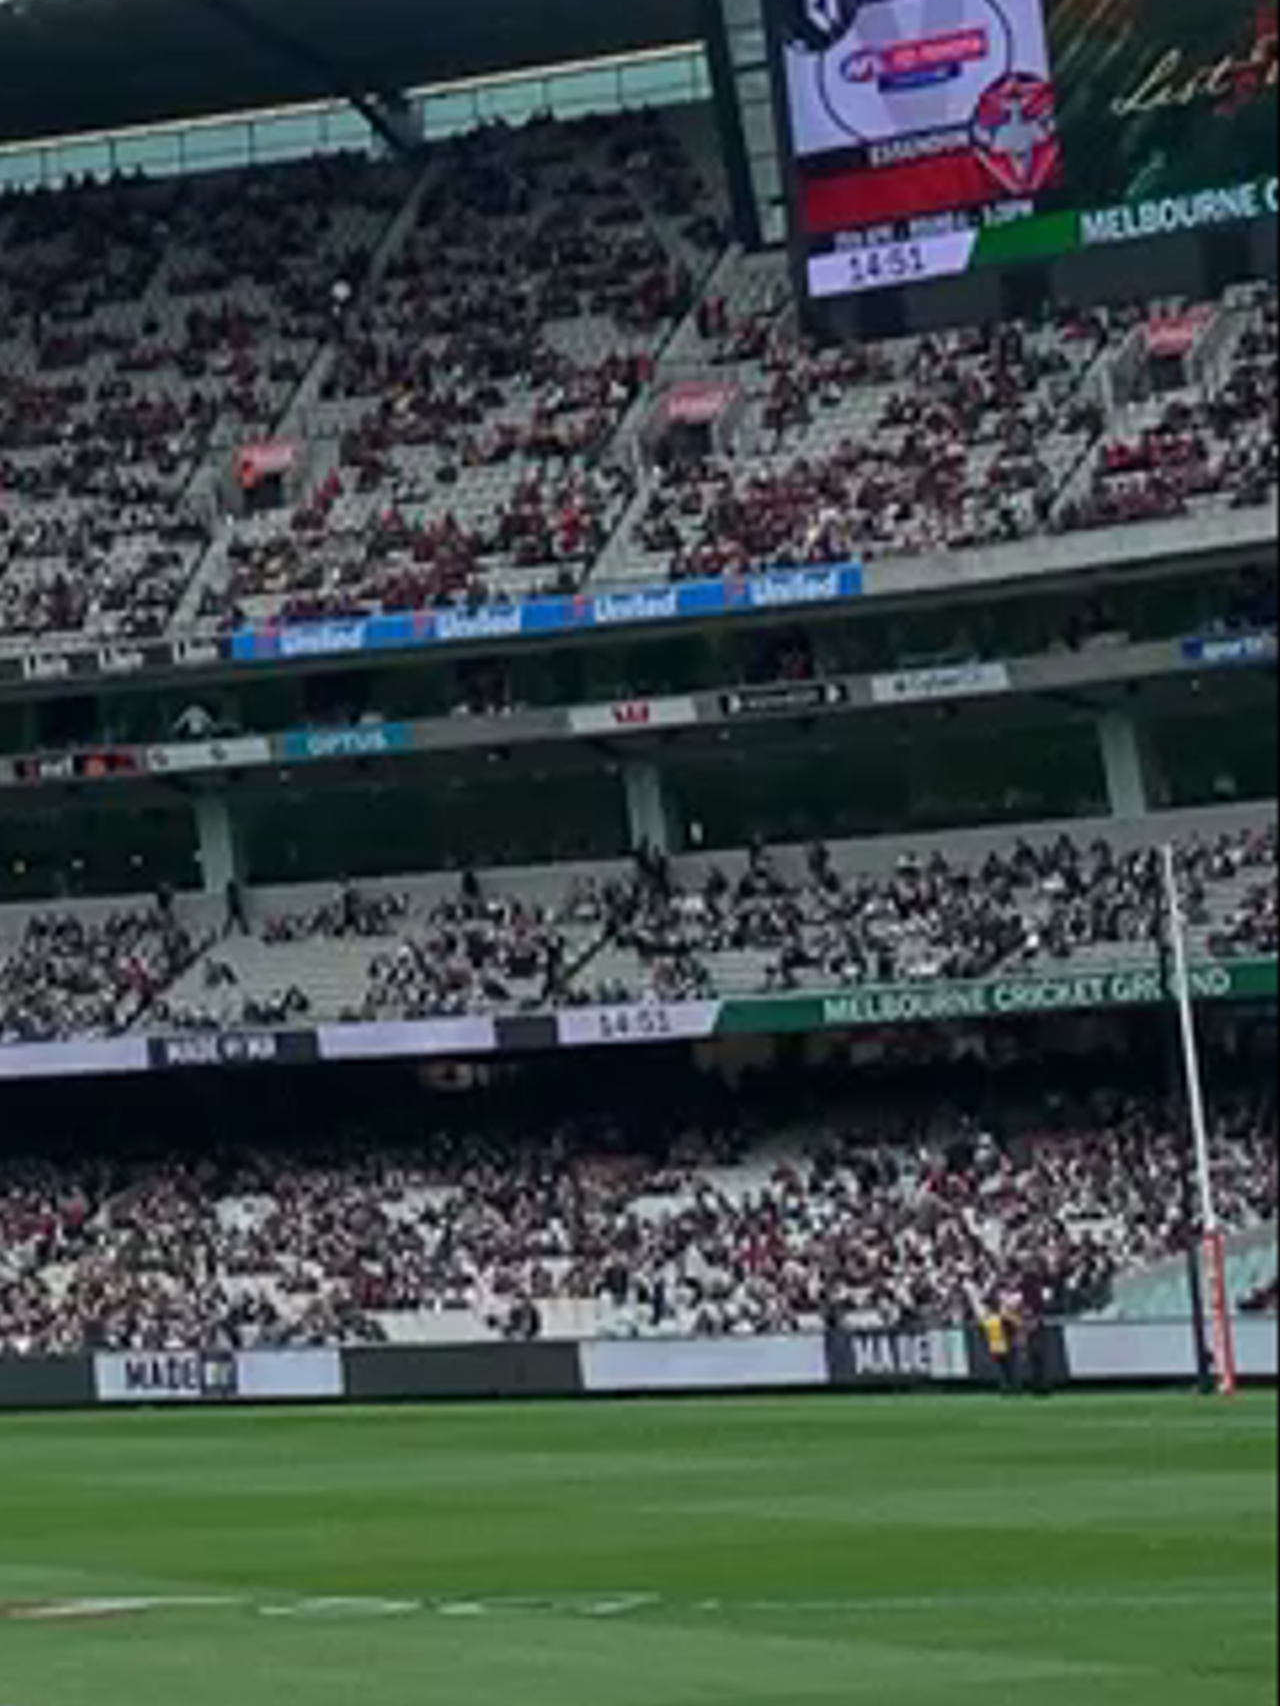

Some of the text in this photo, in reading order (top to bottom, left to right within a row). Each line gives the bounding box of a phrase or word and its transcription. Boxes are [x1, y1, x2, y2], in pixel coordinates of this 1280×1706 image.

[1081, 185, 1258, 245] MELBOURNE
[306, 729, 388, 755] OPTUS
[824, 987, 986, 1022] MELBOURNE
[994, 976, 1104, 1011] CRICKET
[125, 1356, 199, 1390] MADE
[853, 1335, 932, 1374] MADE
